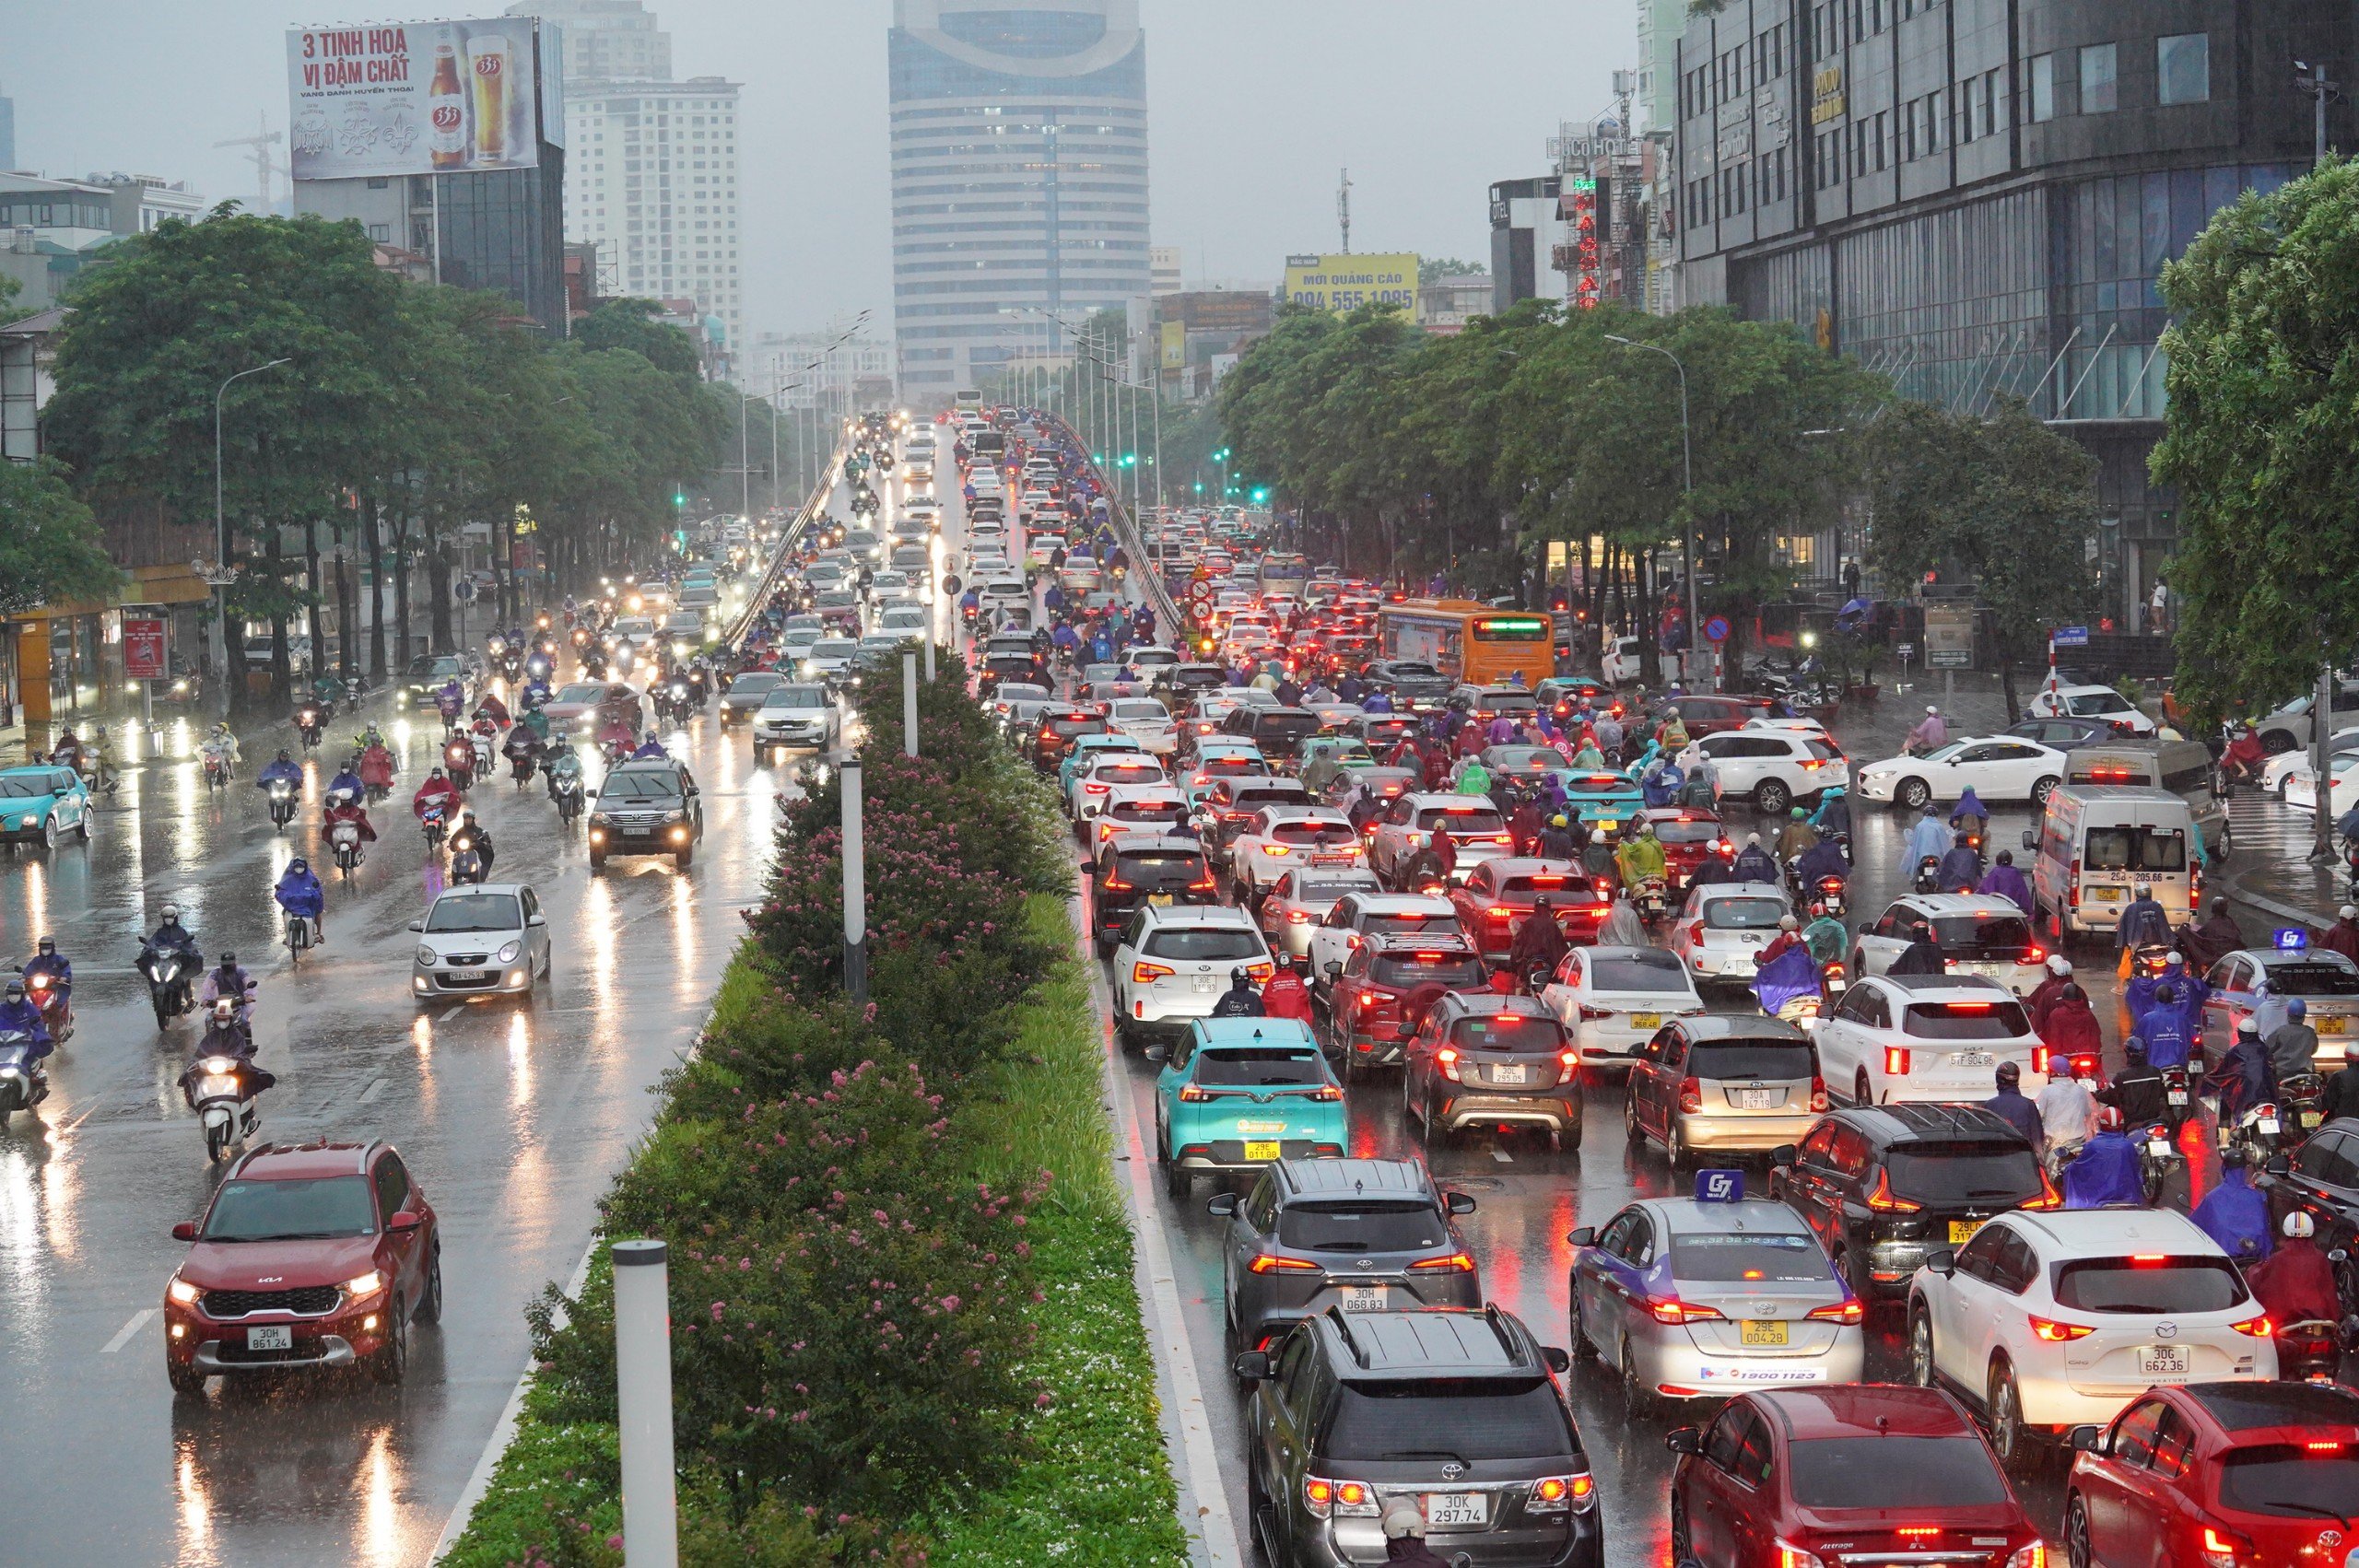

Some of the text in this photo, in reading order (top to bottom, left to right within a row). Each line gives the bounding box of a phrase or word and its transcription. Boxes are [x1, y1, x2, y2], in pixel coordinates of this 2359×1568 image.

[303, 28, 407, 58] 3 TINH HOA
[478, 56, 497, 74] 333
[303, 53, 410, 89] VỊ ĐẬM CHẤT
[435, 105, 458, 125] 333
[1332, 271, 1374, 285] QUẢNG
[1378, 272, 1402, 284] CÁO
[1332, 290, 1364, 310] 555
[2111, 872, 2126, 882] 29B
[2135, 872, 2163, 882] 205.66
[2282, 930, 2298, 946] G7
[1198, 976, 1210, 984] 30E
[1502, 1067, 1516, 1075] 30L
[1749, 1090, 1764, 1099] 30A
[1708, 1174, 1733, 1198] G7
[1356, 1289, 1375, 1299] 30H
[1346, 1299, 1383, 1309] 068.83
[1754, 1322, 1774, 1332] 29E
[260, 1328, 279, 1339] 30H
[1746, 1332, 1783, 1343] 004.28
[252, 1339, 288, 1349] 861.24
[2154, 1349, 2175, 1359] 30G
[2145, 1360, 2183, 1371] 662.36
[1445, 1496, 1470, 1508] 30K
[1435, 1510, 1481, 1522] 297.74
